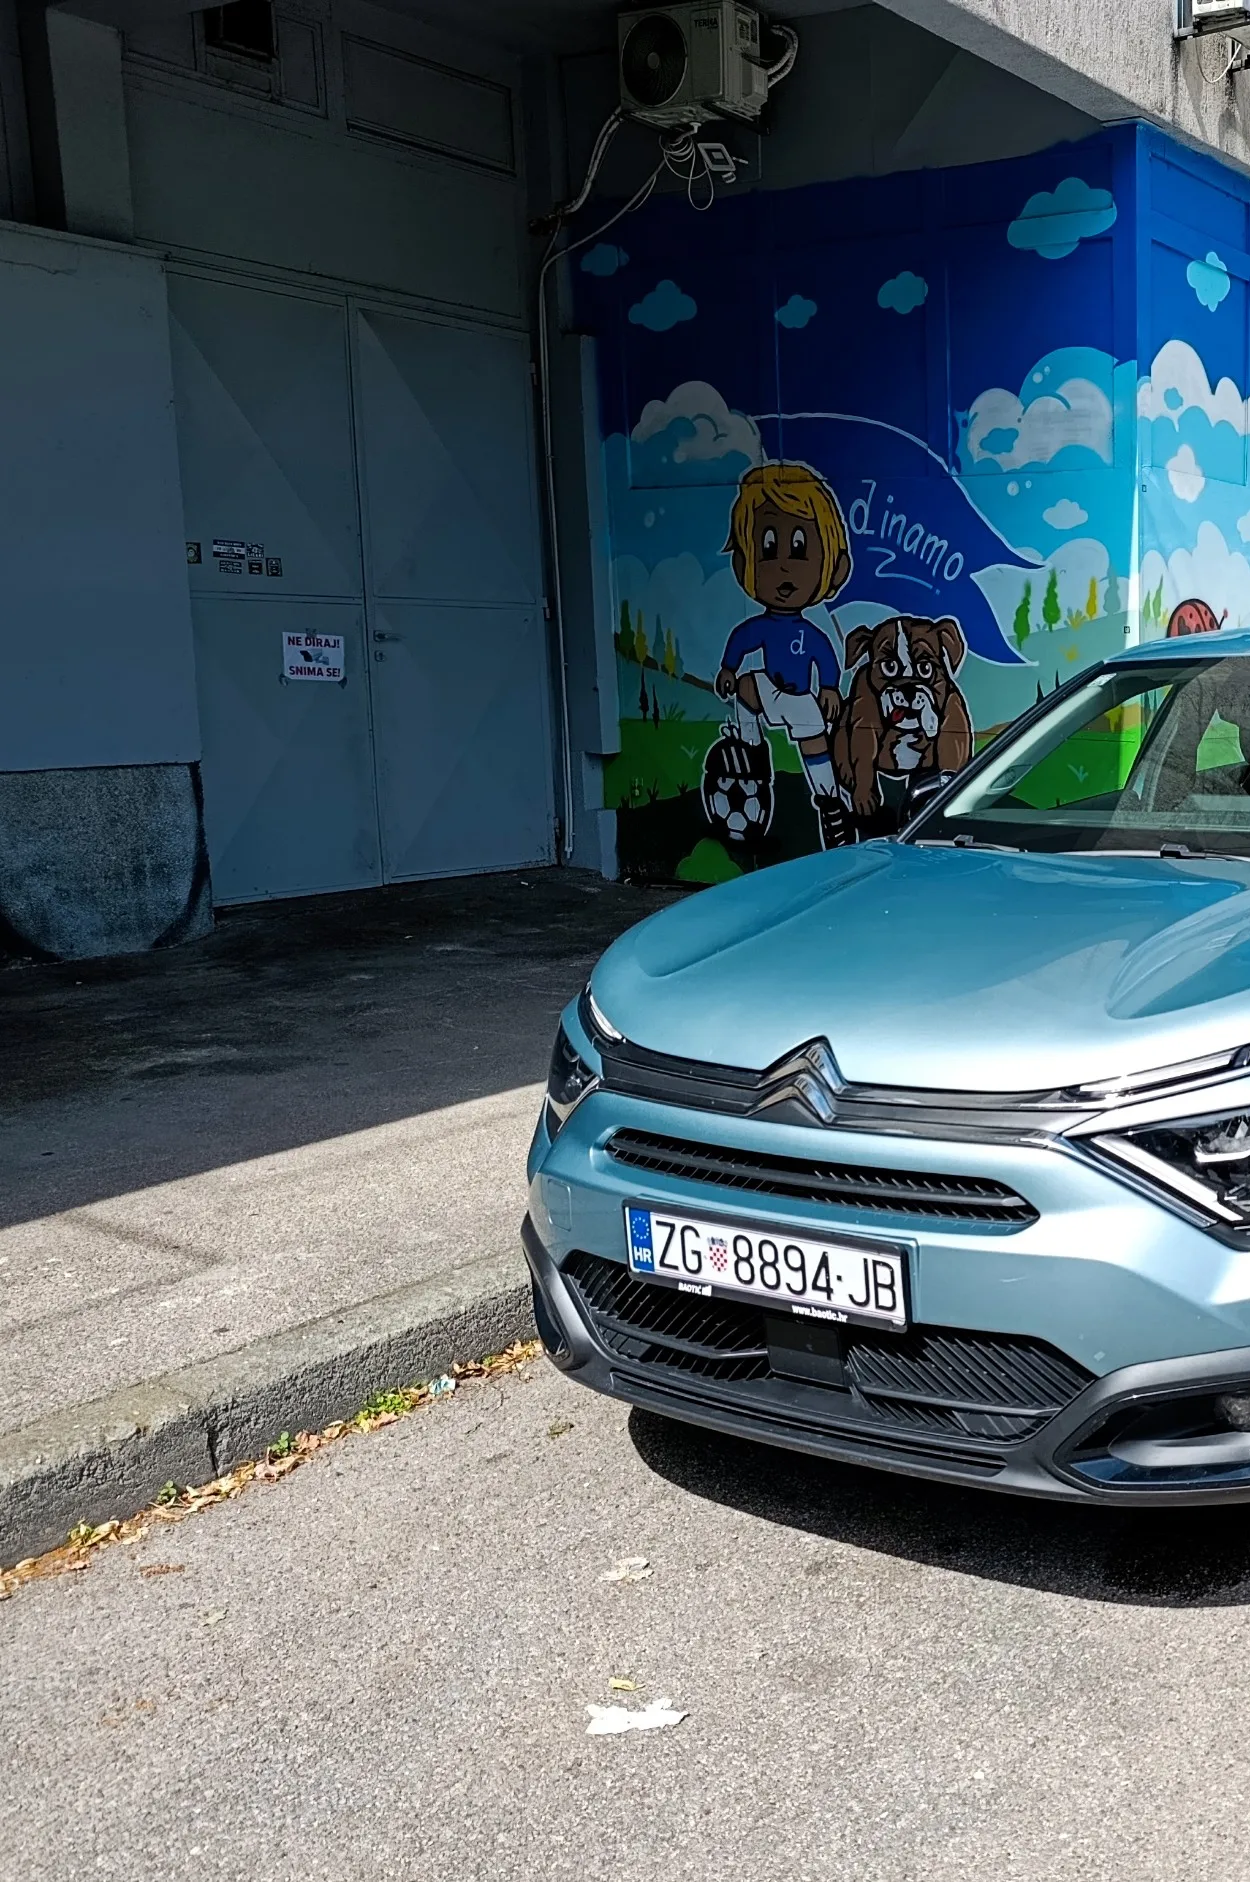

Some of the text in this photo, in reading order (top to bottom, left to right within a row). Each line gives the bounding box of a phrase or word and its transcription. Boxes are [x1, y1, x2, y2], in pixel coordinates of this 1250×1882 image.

[849, 479, 965, 581] dinamo
[287, 636, 340, 649] NE DIRAJ!
[289, 666, 341, 678] SNIMA SE!
[633, 1246, 652, 1264] HR
[655, 1219, 703, 1275] ZG
[791, 1304, 848, 1323] www.baotic.hr
